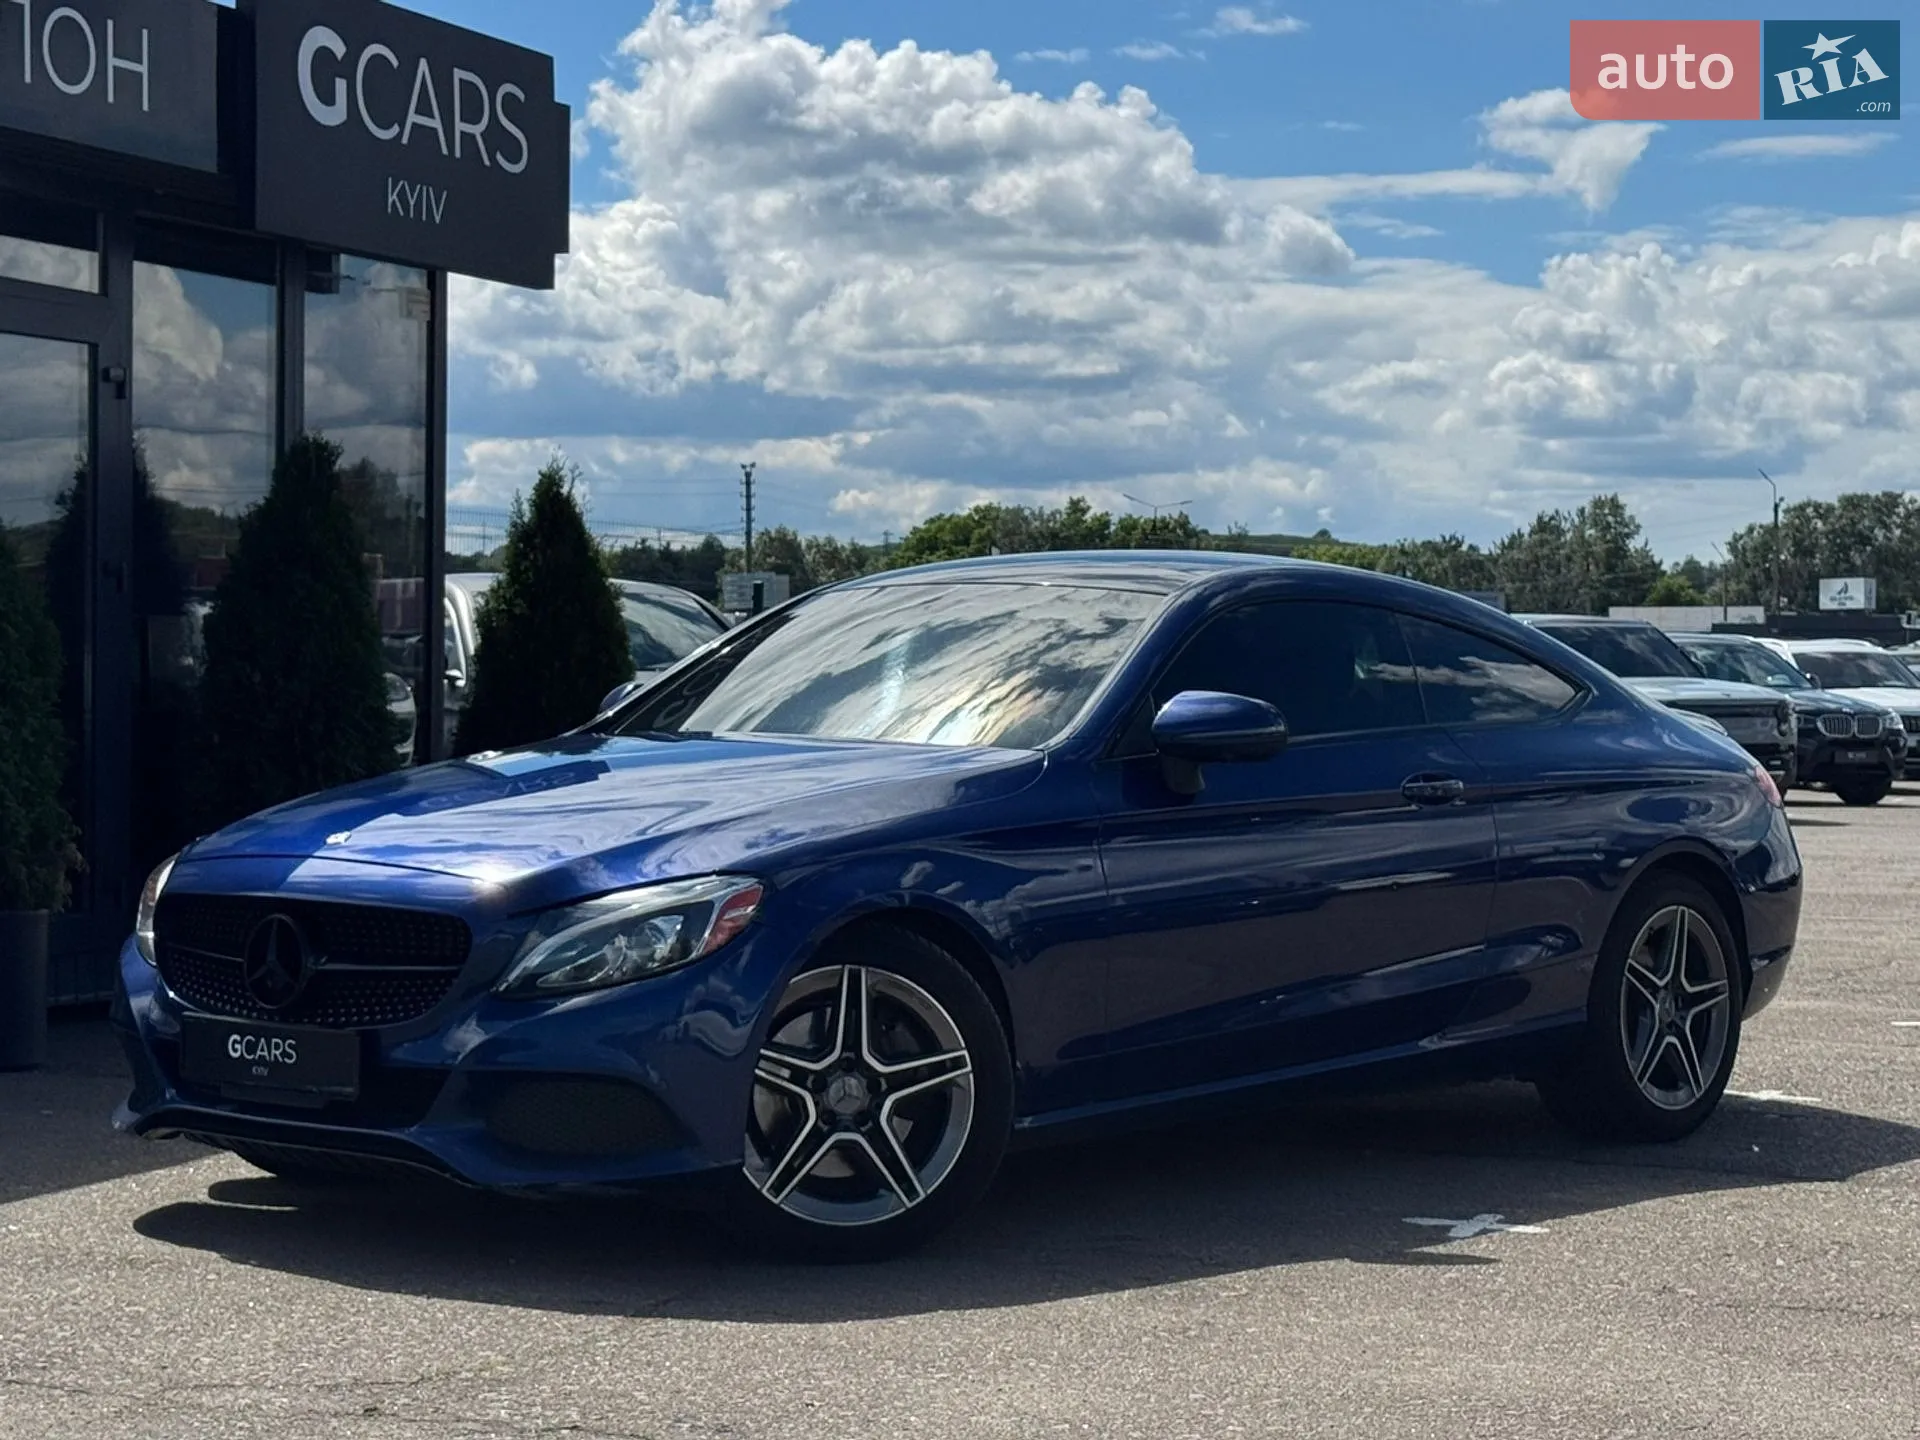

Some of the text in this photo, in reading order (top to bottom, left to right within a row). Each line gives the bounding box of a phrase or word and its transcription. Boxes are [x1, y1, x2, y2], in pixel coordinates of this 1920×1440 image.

[297, 25, 529, 174] GCARS
[387, 176, 447, 224] KYIV
[227, 1033, 297, 1064] GCARS
